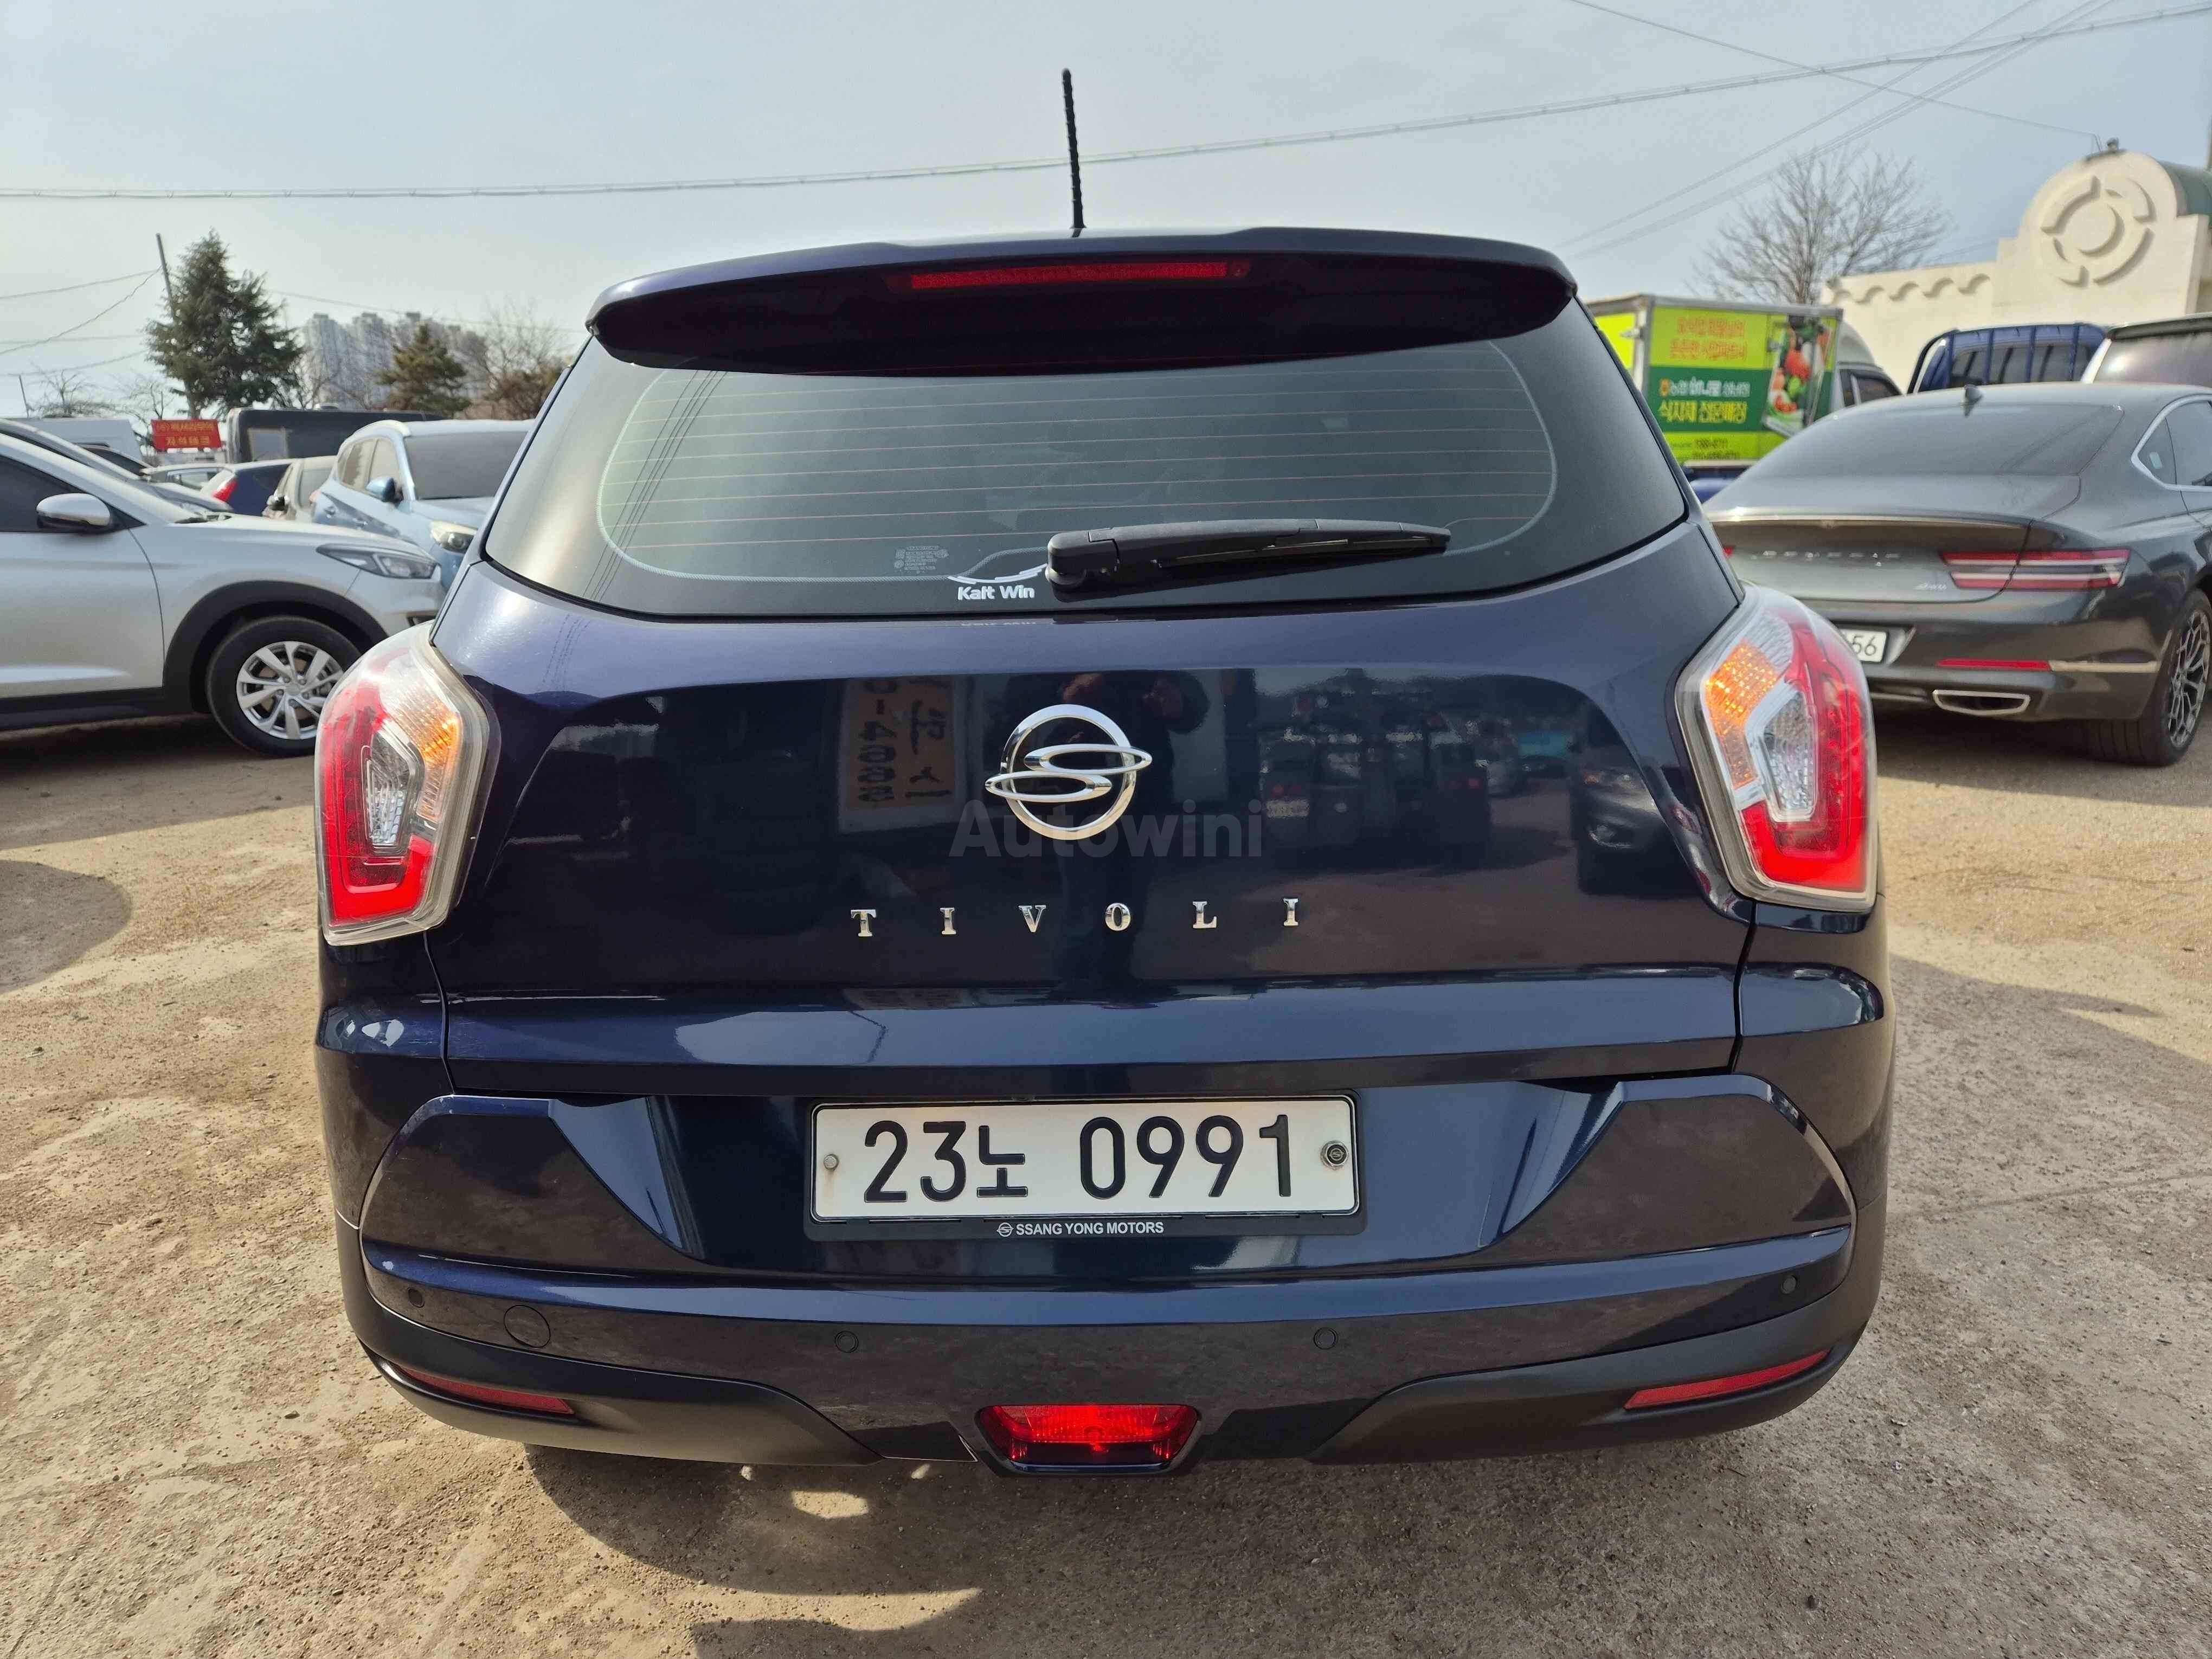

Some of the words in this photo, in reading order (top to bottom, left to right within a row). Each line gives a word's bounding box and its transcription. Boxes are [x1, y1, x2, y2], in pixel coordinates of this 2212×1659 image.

[999, 584, 1035, 599] Win
[850, 897, 1300, 937] TIVOLI
[864, 1120, 1028, 1203] 23노
[1079, 1114, 1291, 1200] 0991
[1016, 1223, 1062, 1235] SSANG
[1064, 1223, 1104, 1234] YONG
[1107, 1221, 1164, 1234] MOTORS
